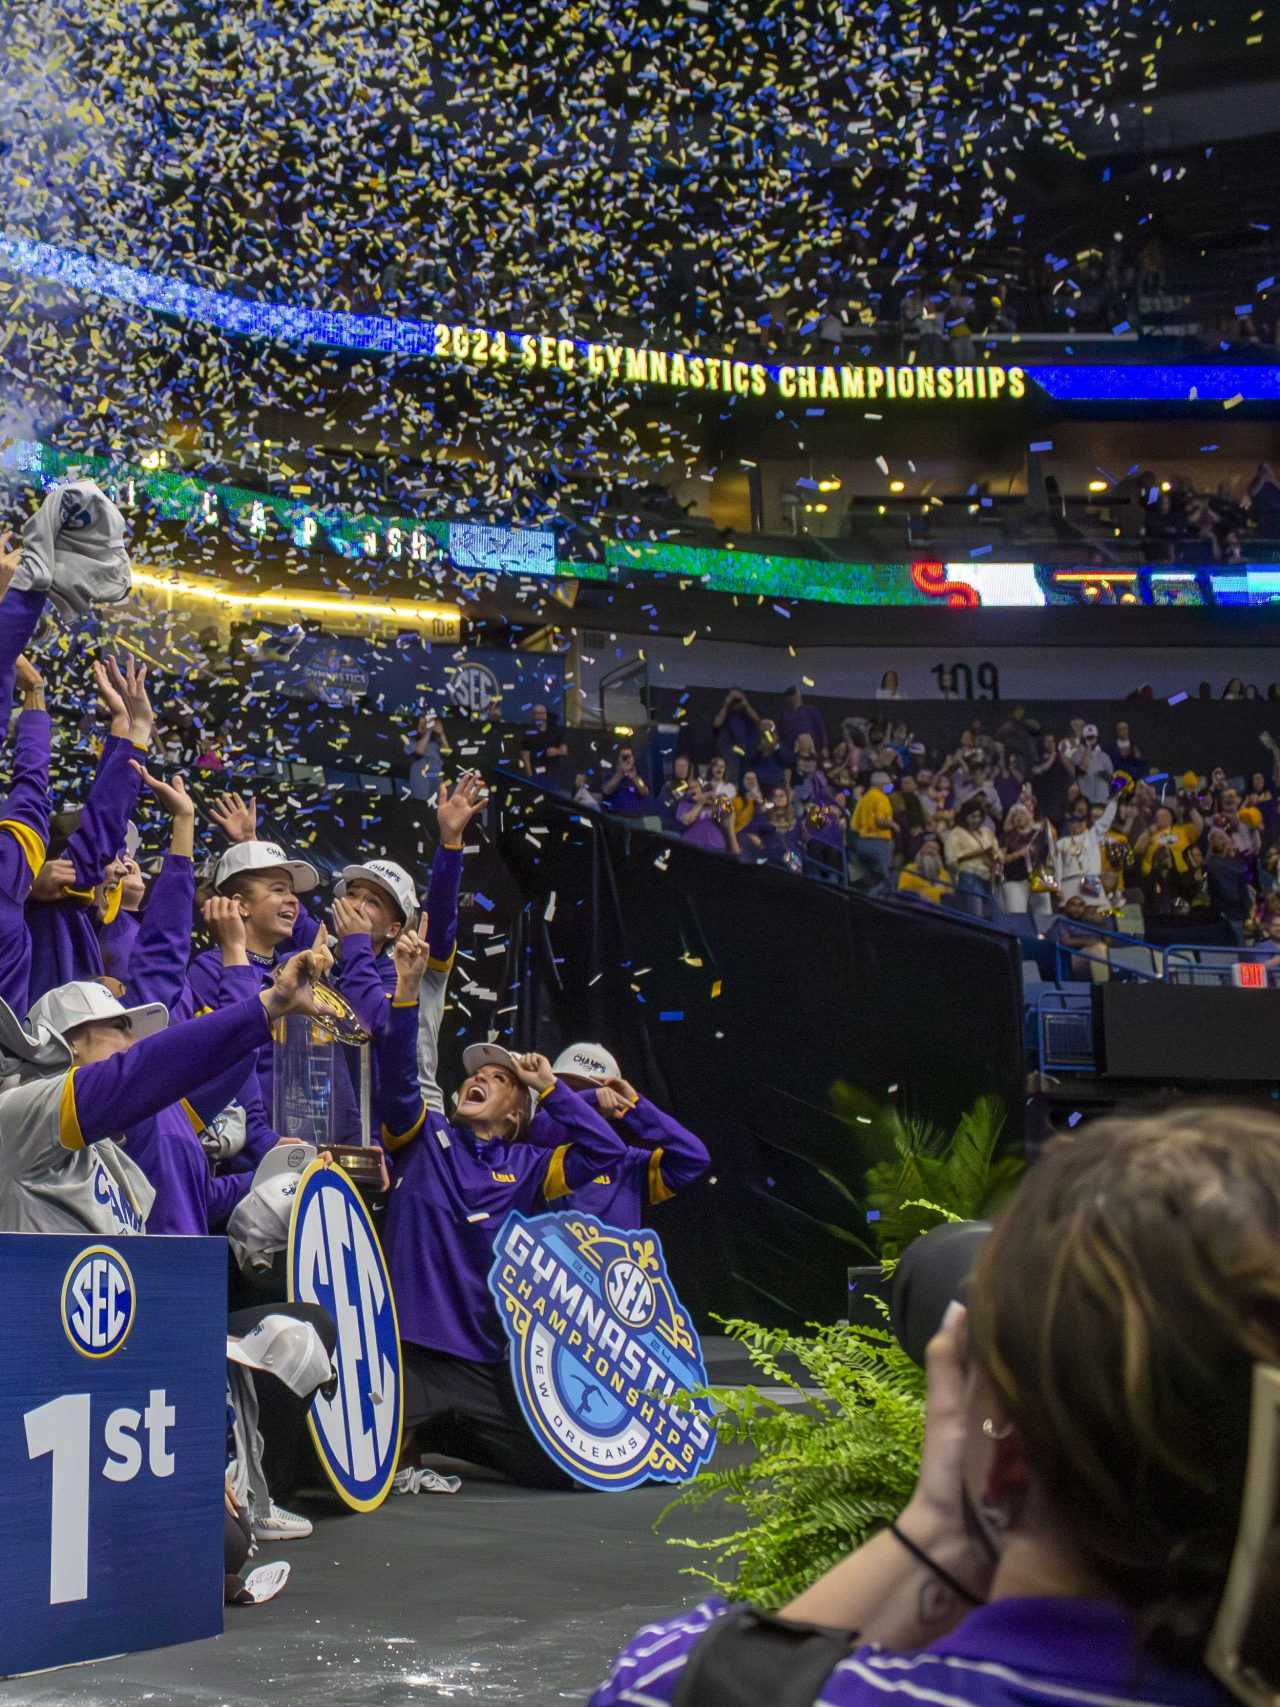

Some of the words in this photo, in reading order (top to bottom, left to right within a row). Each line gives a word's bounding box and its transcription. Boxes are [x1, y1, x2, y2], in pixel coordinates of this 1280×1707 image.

[434, 323, 508, 363] 2024
[521, 334, 574, 371] SEC
[588, 343, 767, 396] GYMNASTICS
[779, 366, 1025, 399] CHAMPIONSHIPS
[452, 668, 493, 709] SEC
[369, 864, 402, 884] CHAMPS
[70, 1258, 127, 1347] SEC
[298, 1186, 396, 1482] SEC
[505, 1224, 711, 1450] GYMNASTICS
[608, 1261, 653, 1323] SEC
[502, 1264, 697, 1466] CHAMPIONSHIPS
[534, 1343, 551, 1399] NEW
[552, 1414, 639, 1459] ORLEANS
[22, 1388, 177, 1606] 1st
